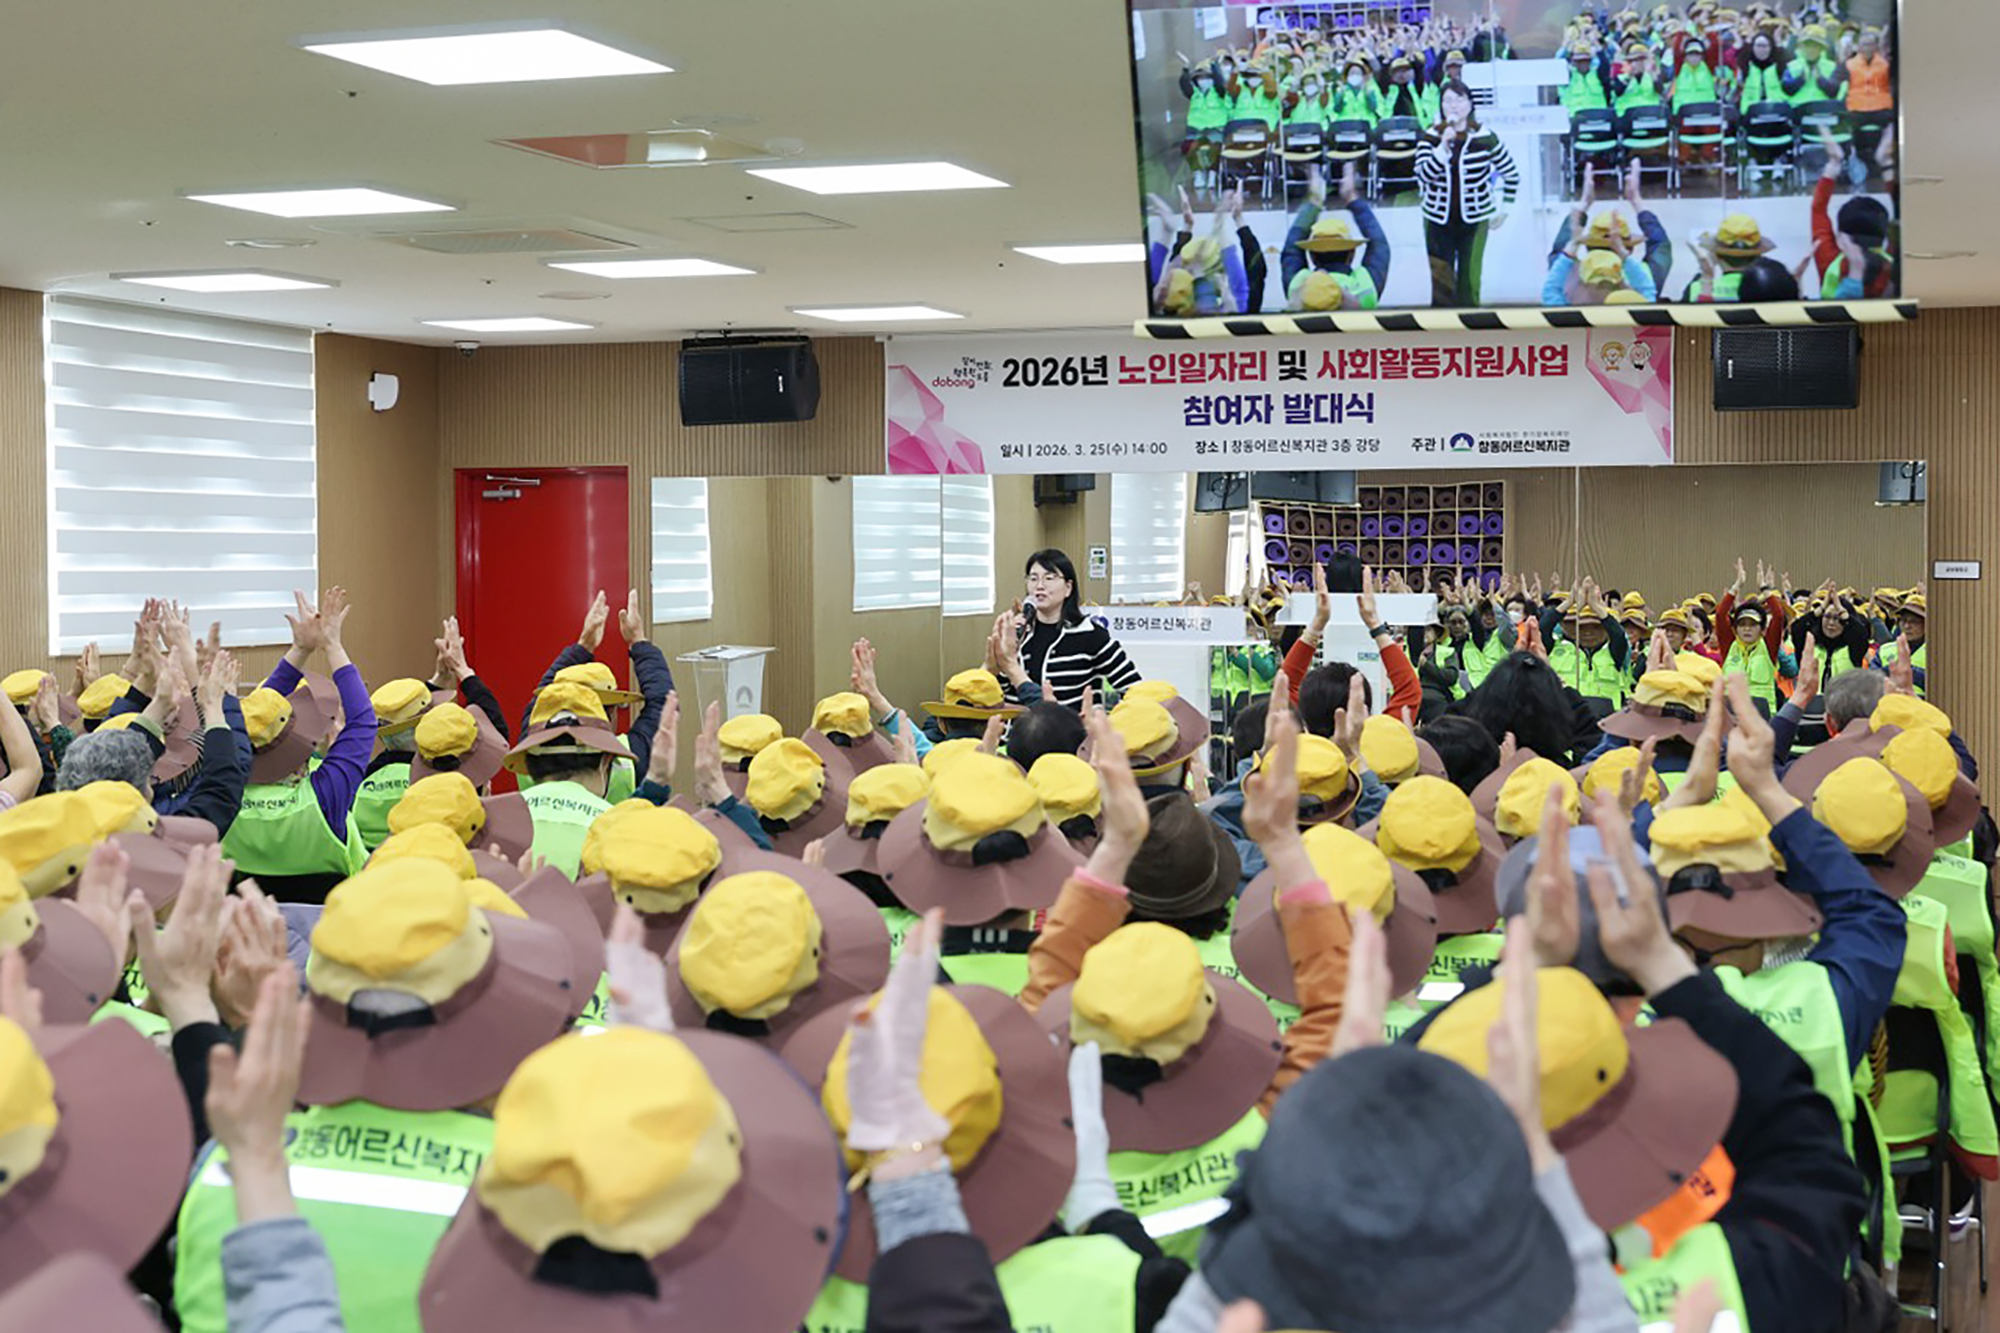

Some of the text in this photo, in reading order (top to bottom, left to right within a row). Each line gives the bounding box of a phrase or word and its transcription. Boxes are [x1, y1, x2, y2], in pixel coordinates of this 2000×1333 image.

[1002, 344, 1569, 388] 2026년 노인일자리 및 사회활동지원사업
[932, 376, 975, 389] dobong
[1183, 392, 1375, 427] 참여자 발대식
[1000, 443, 1024, 458] 일시
[1035, 443, 1071, 457] 2026.
[1075, 443, 1086, 456] 3.
[1090, 442, 1128, 456] 25(수)
[1131, 442, 1168, 455] 14:00
[1194, 440, 1220, 455] 장소
[1231, 438, 1328, 455] 창동어르신복지관
[1331, 438, 1352, 454] 3층
[1355, 438, 1381, 453] 강당
[1411, 437, 1436, 452] 주관
[1478, 439, 1571, 454] 창동어르신복지관
[1113, 616, 1212, 632] 창동어르신복지관
